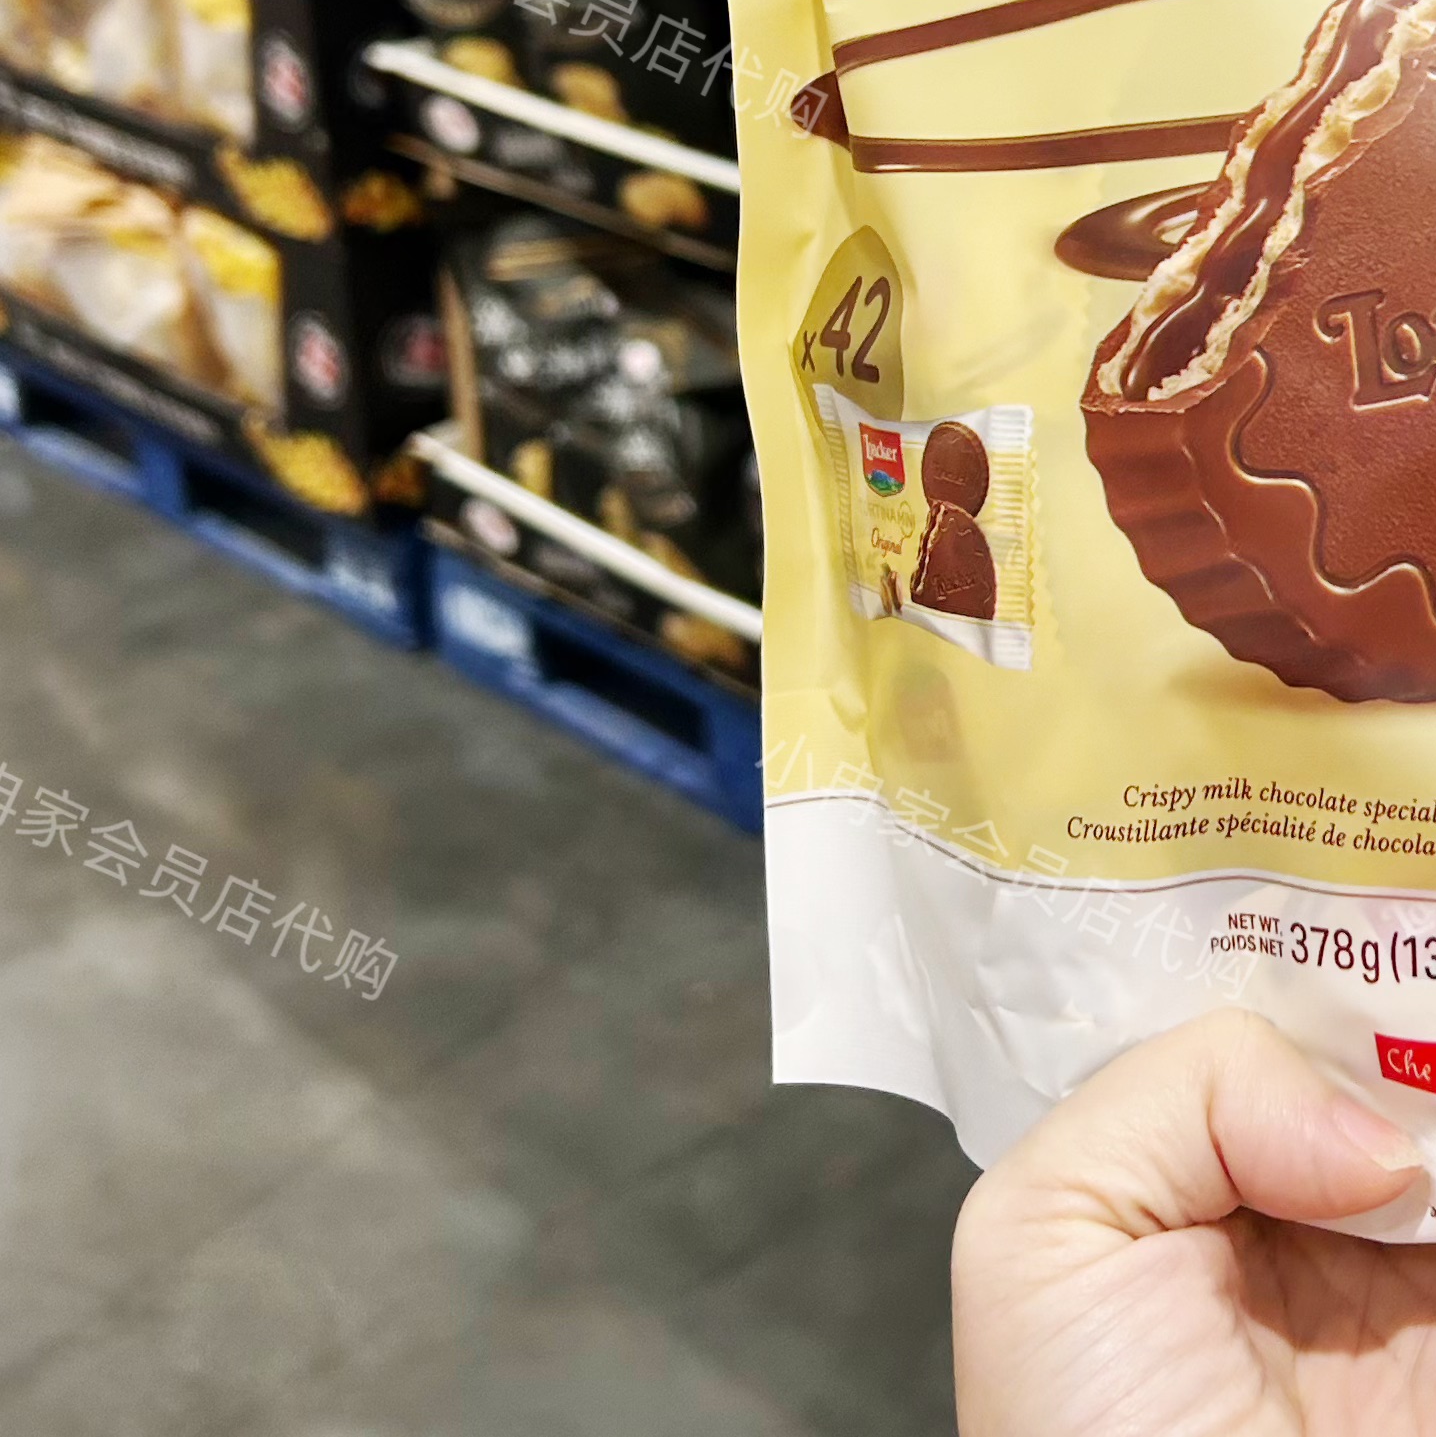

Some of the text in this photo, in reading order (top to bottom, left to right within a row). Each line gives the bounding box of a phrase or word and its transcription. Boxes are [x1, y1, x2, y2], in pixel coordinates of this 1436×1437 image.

[1123, 785, 1197, 812] Crispy
[1203, 777, 1253, 801] milk
[1259, 781, 1358, 815] chocolate
[1067, 815, 1211, 843] Croustillante
[1216, 810, 1317, 843] spécialité
[1322, 825, 1347, 848] de
[1228, 913, 1284, 936] NET WT.
[1211, 935, 1284, 958] POIDS NET
[1387, 1047, 1432, 1082] Che
